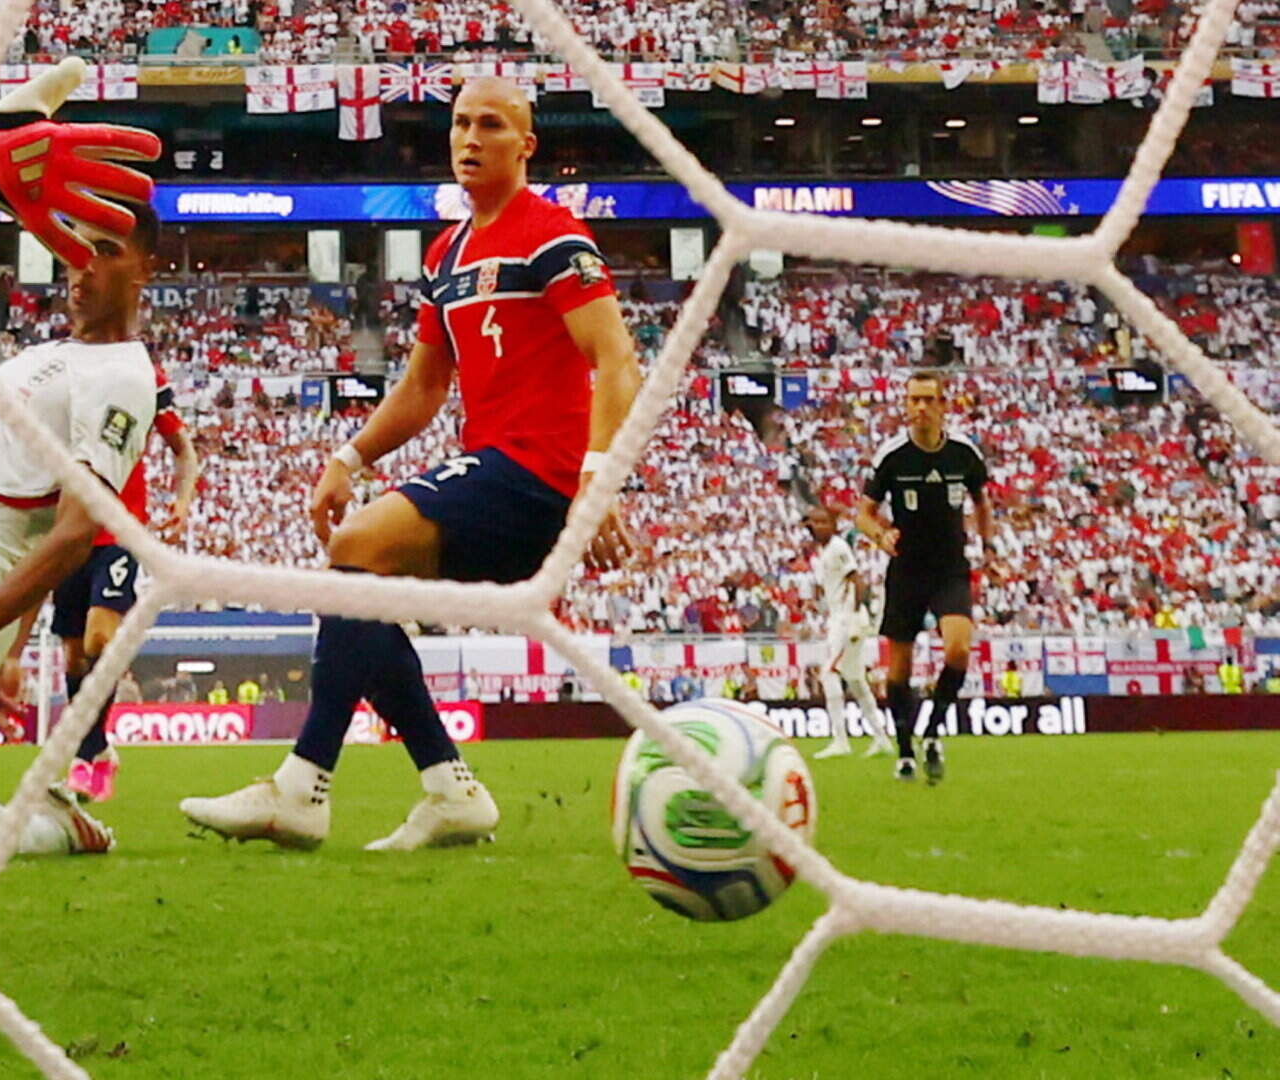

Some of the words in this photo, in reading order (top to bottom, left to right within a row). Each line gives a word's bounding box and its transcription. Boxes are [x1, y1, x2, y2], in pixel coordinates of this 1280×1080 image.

[755, 187, 853, 212] MIAMI
[1201, 183, 1266, 209] FIFA
[481, 306, 503, 358] 4
[435, 455, 481, 482] 4
[109, 555, 128, 587] 6
[106, 712, 246, 744] enovo
[968, 698, 1028, 736] for
[1037, 696, 1086, 735] all
